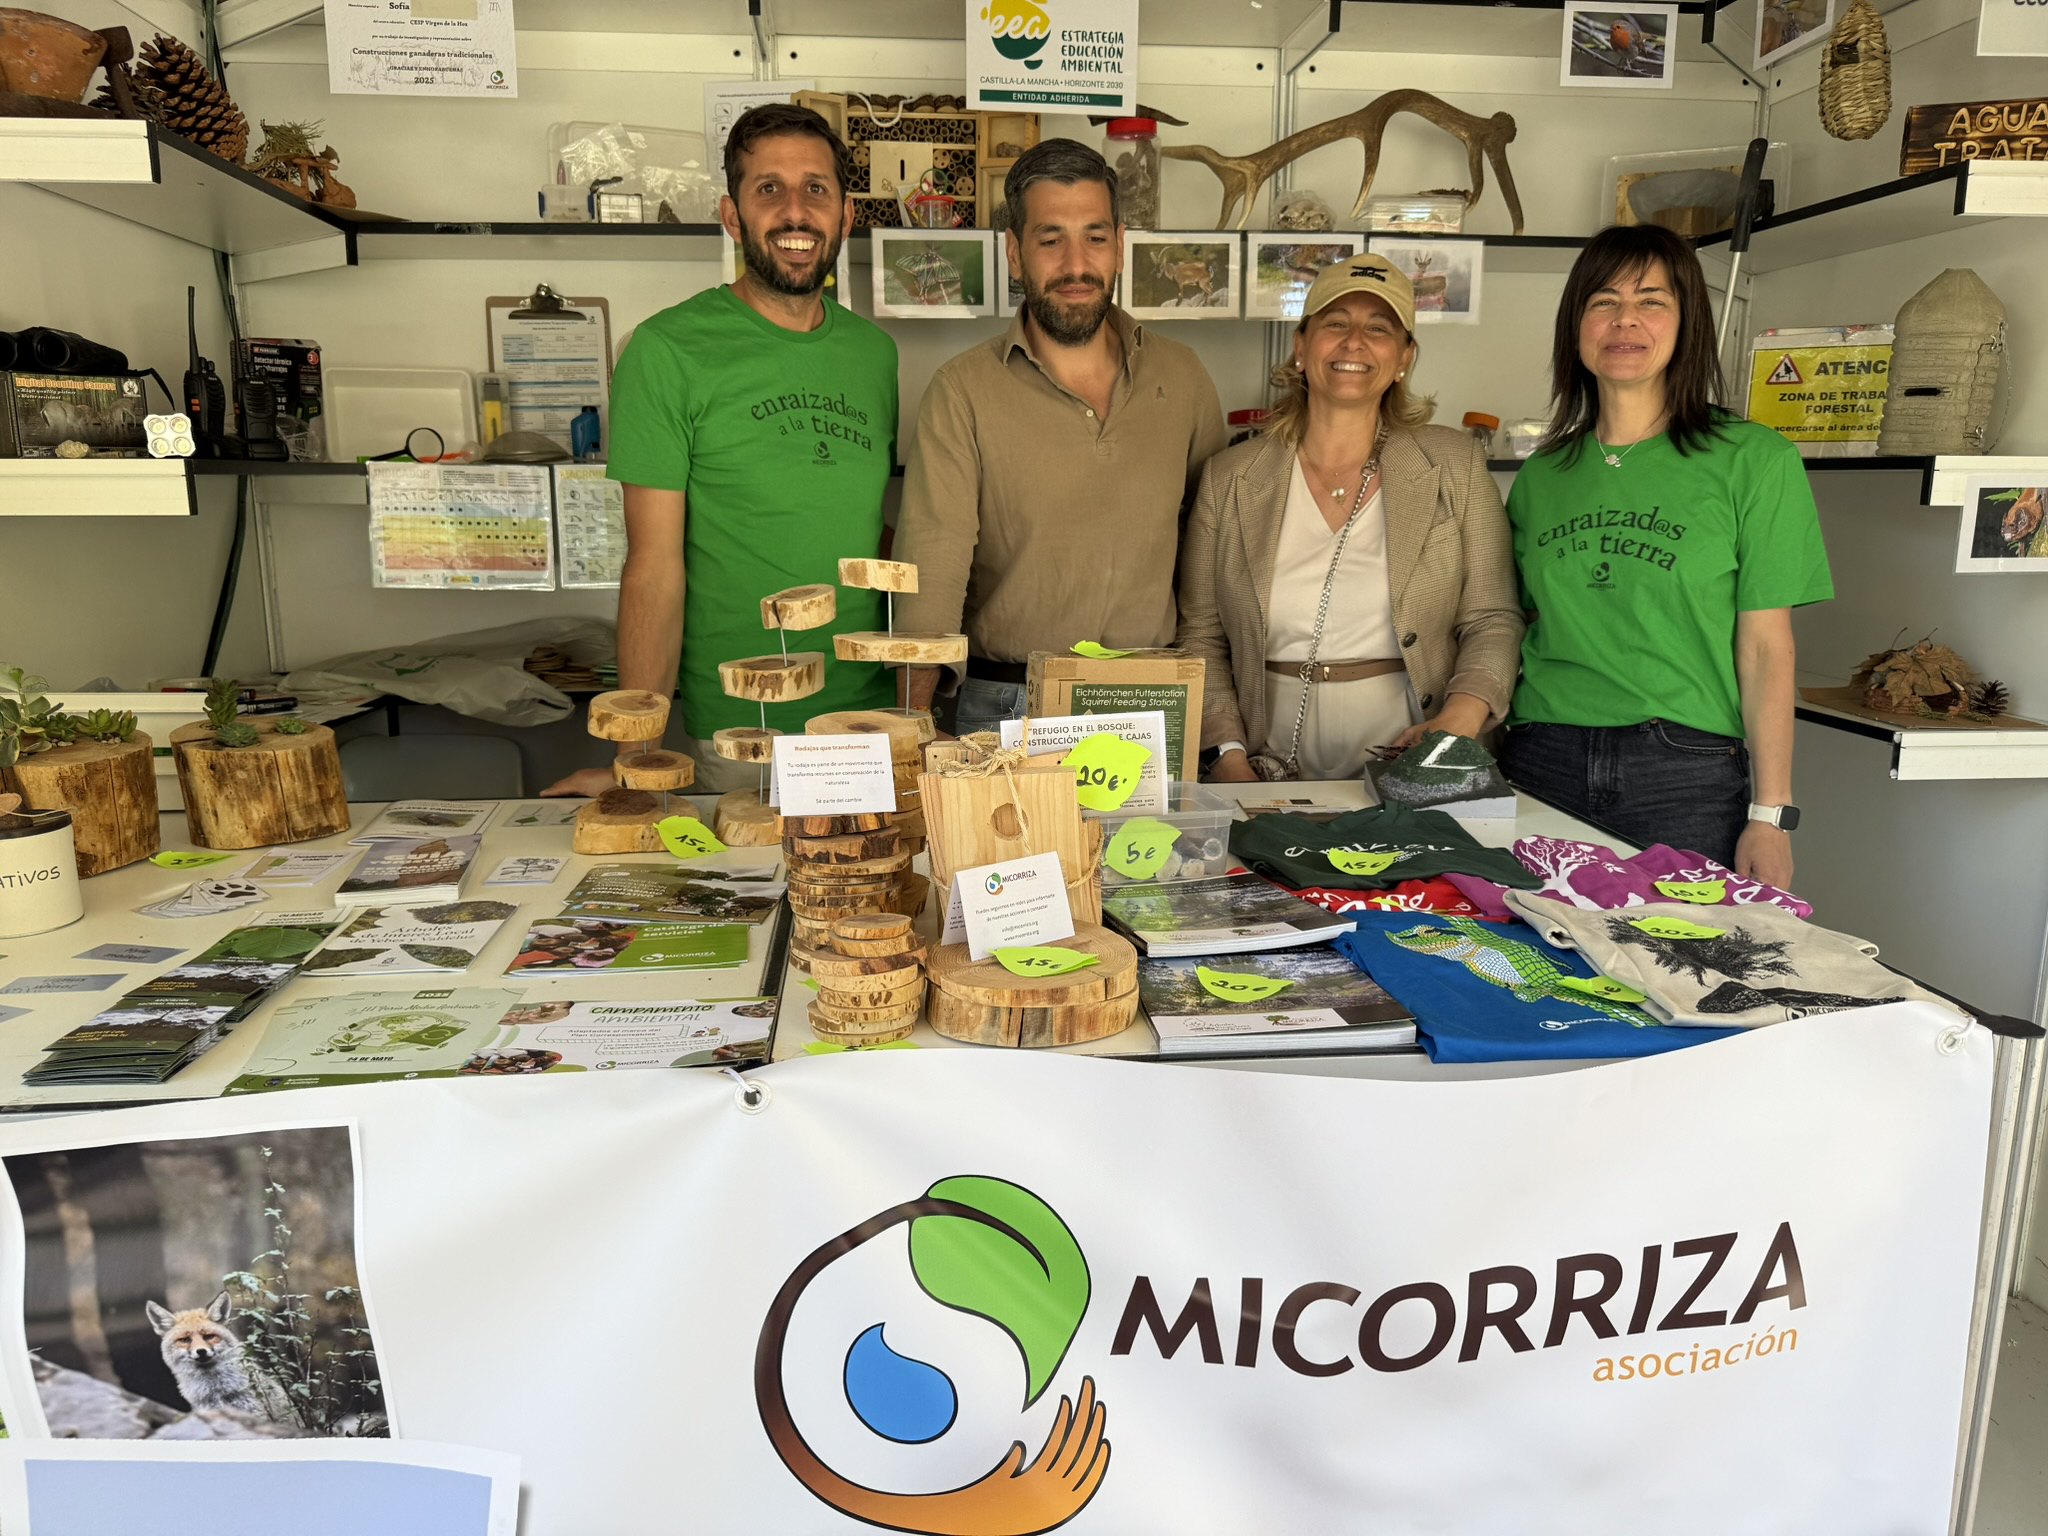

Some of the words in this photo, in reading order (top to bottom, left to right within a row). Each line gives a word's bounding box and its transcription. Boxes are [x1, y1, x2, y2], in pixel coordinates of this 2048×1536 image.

[389, 2, 410, 10] Sofía
[425, 20, 443, 28] Virgen
[991, 15, 1046, 40] eea
[1061, 30, 1124, 44] ESTRATEGIA
[352, 48, 407, 57] Construcciones
[409, 50, 445, 58] ganaderas
[447, 51, 493, 59] tradicionales
[1061, 43, 1124, 59] EDUCACIÓN
[1061, 59, 1123, 74] AMBIENTAL
[980, 76, 1025, 85] CASTILLA-LA
[1027, 78, 1059, 86] MANCHA
[1065, 80, 1105, 88] HORIZONTE
[1106, 81, 1124, 89] 2030
[1012, 92, 1047, 102] ENTIDAD
[1050, 94, 1090, 104] ADHERIDA
[1947, 103, 2048, 136] AGUA
[1933, 137, 2048, 168] TRAT
[1350, 267, 1387, 283] adidas
[254, 356, 274, 365] Detector
[1814, 360, 1888, 376] ATENC
[15, 377, 46, 389] Digital
[46, 378, 84, 390] Scouting
[84, 380, 117, 391] Camera
[1779, 392, 1815, 401] ZONA
[1819, 392, 1837, 401] DE
[1841, 391, 1886, 400] TRABA
[1805, 404, 1874, 414] FORESTAL
[1838, 423, 1863, 432] área
[779, 425, 788, 436] a
[788, 416, 805, 431] la
[811, 415, 872, 452] tierra
[1537, 505, 1687, 548] enraizad@s
[1556, 547, 1565, 559] a
[1571, 538, 1588, 552] la
[1600, 531, 1677, 572] tierra
[1076, 688, 1133, 697] Eichhörnchen
[1135, 688, 1186, 698] Futterstation
[1081, 698, 1112, 707] Squirrel
[1113, 698, 1147, 708] Feeding
[1072, 725, 1083, 733] EN
[1097, 722, 1136, 733] BOSQUE:
[1126, 732, 1152, 741] CAJAS
[1002, 870, 1037, 883] MICORRIZA
[437, 928, 475, 936] Local
[643, 928, 704, 937] servicios
[644, 922, 701, 932] Catálogo
[664, 951, 717, 959] MICORRIZA
[417, 991, 450, 999] 2025
[591, 1005, 713, 1014] CAMPAMENTO
[593, 1013, 701, 1024] AMBIENTAL
[1110, 1221, 1807, 1377] MICORRIZA
[1593, 1324, 1798, 1382] asociación
